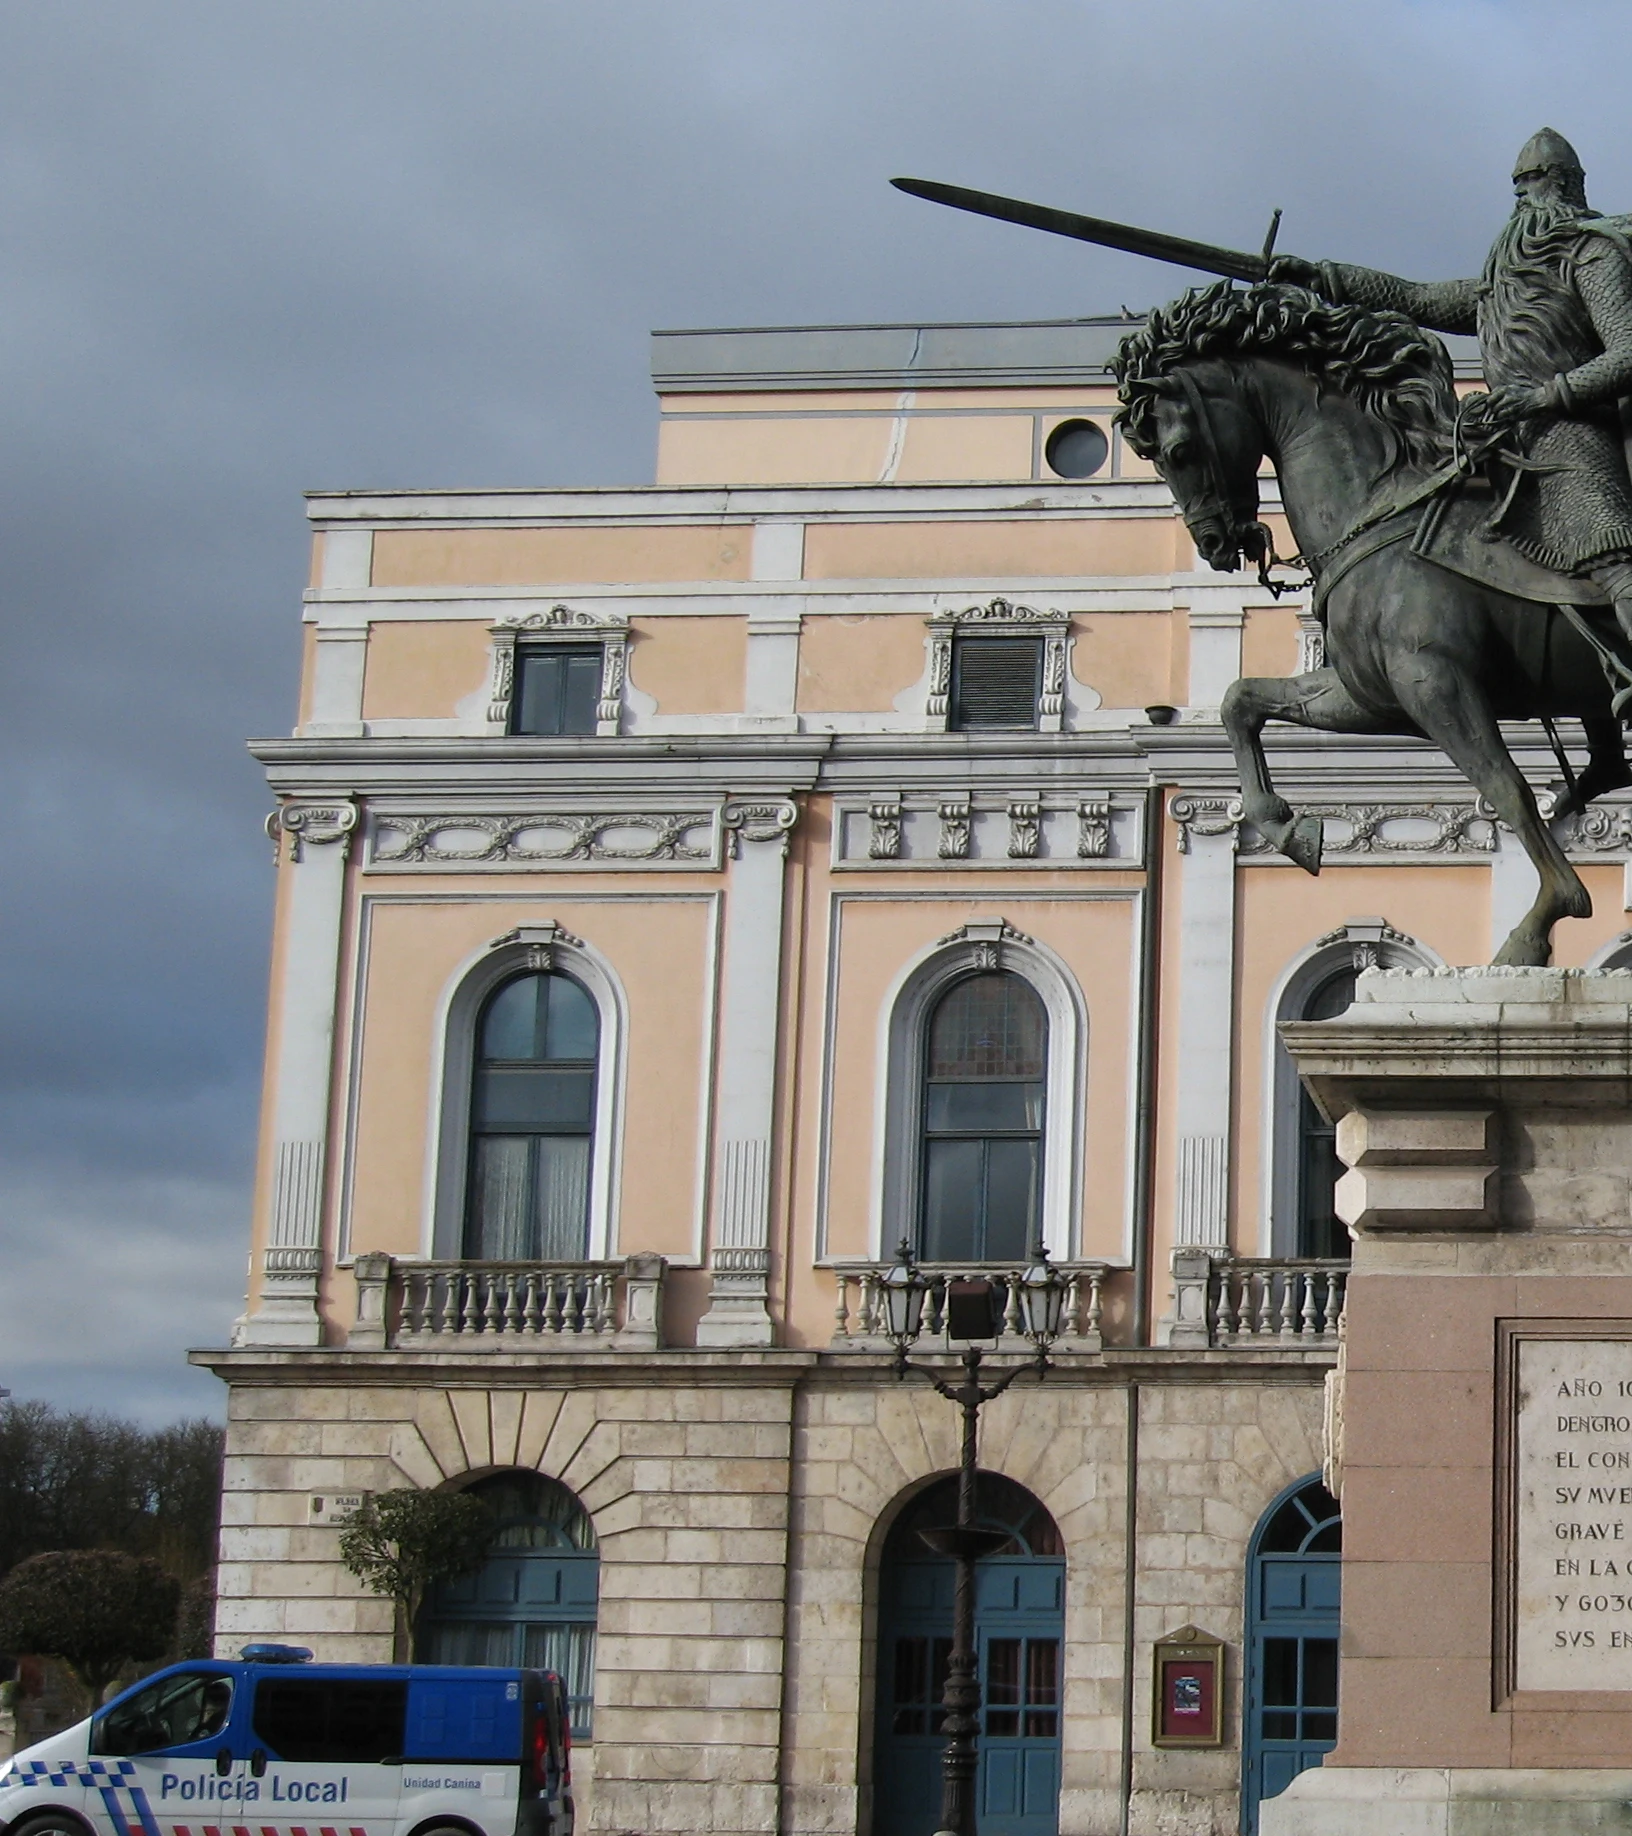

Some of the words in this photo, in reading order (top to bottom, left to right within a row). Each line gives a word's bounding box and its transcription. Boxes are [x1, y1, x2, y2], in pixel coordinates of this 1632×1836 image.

[1557, 1379, 1603, 1398] AÑO
[1557, 1416, 1631, 1433] DENTRO
[1555, 1451, 1580, 1469] EL
[1555, 1487, 1581, 1506] SV
[1555, 1523, 1625, 1541] GRAVE
[1555, 1559, 1580, 1577] EN
[1588, 1559, 1618, 1577] LA
[1554, 1594, 1571, 1613] Y
[1555, 1630, 1595, 1649] SVS
[161, 1773, 260, 1800] Policía
[273, 1775, 348, 1803] Local
[404, 1777, 441, 1788] Unidad
[444, 1778, 481, 1789] Canina
